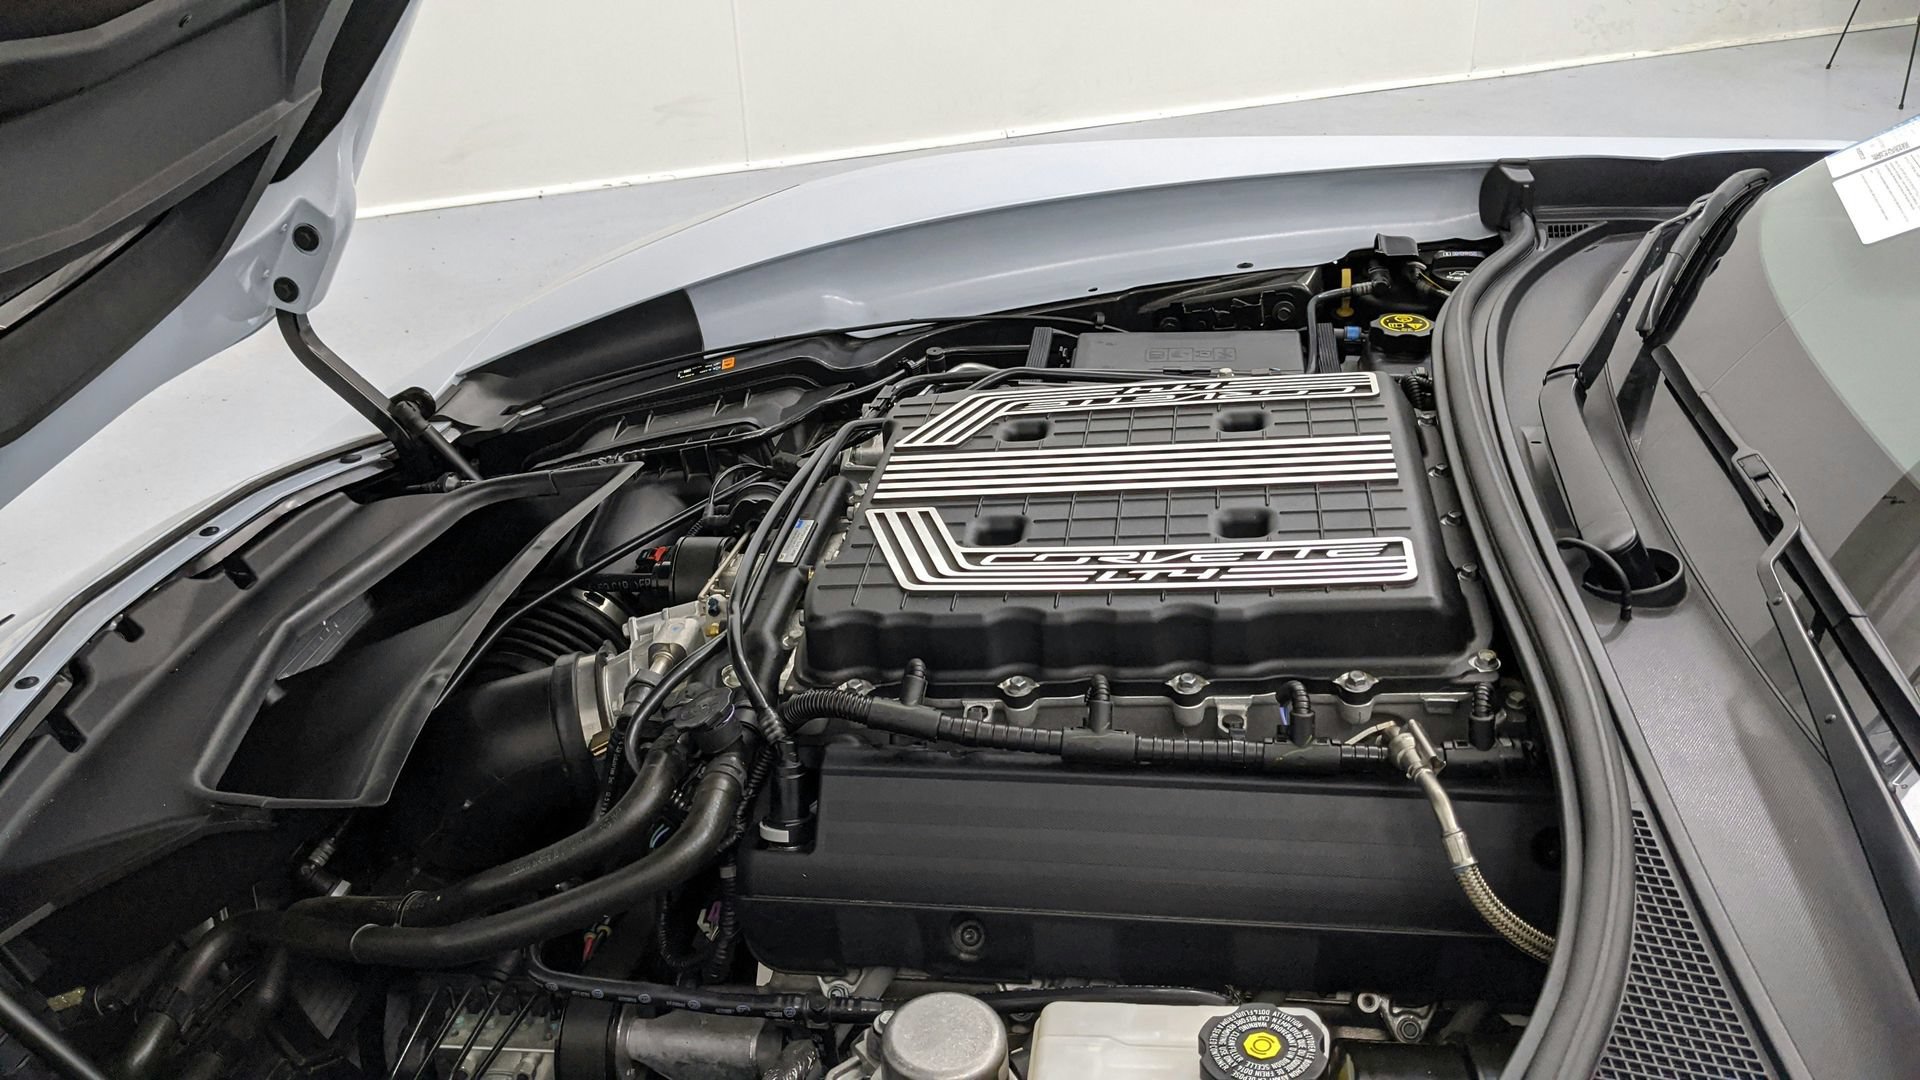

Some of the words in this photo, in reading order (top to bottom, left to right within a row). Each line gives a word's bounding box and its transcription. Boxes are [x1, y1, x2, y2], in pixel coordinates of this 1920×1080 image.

[1022, 385, 1356, 411] CORVETTE
[979, 543, 1389, 566] CORVETTE
[1095, 567, 1220, 582] LT4
[1234, 1009, 1253, 1018] FLUID
[1220, 1015, 1237, 1026] FROM
[1232, 1015, 1257, 1026] BEFORE
[1209, 1027, 1222, 1048] SEALED
[1228, 1031, 1240, 1045] CLEAN
[1219, 1046, 1228, 1055] USE
[1228, 1046, 1244, 1063] FILLER
[1222, 1055, 1238, 1067] ONLY
[1235, 1065, 1254, 1075] DOT4
